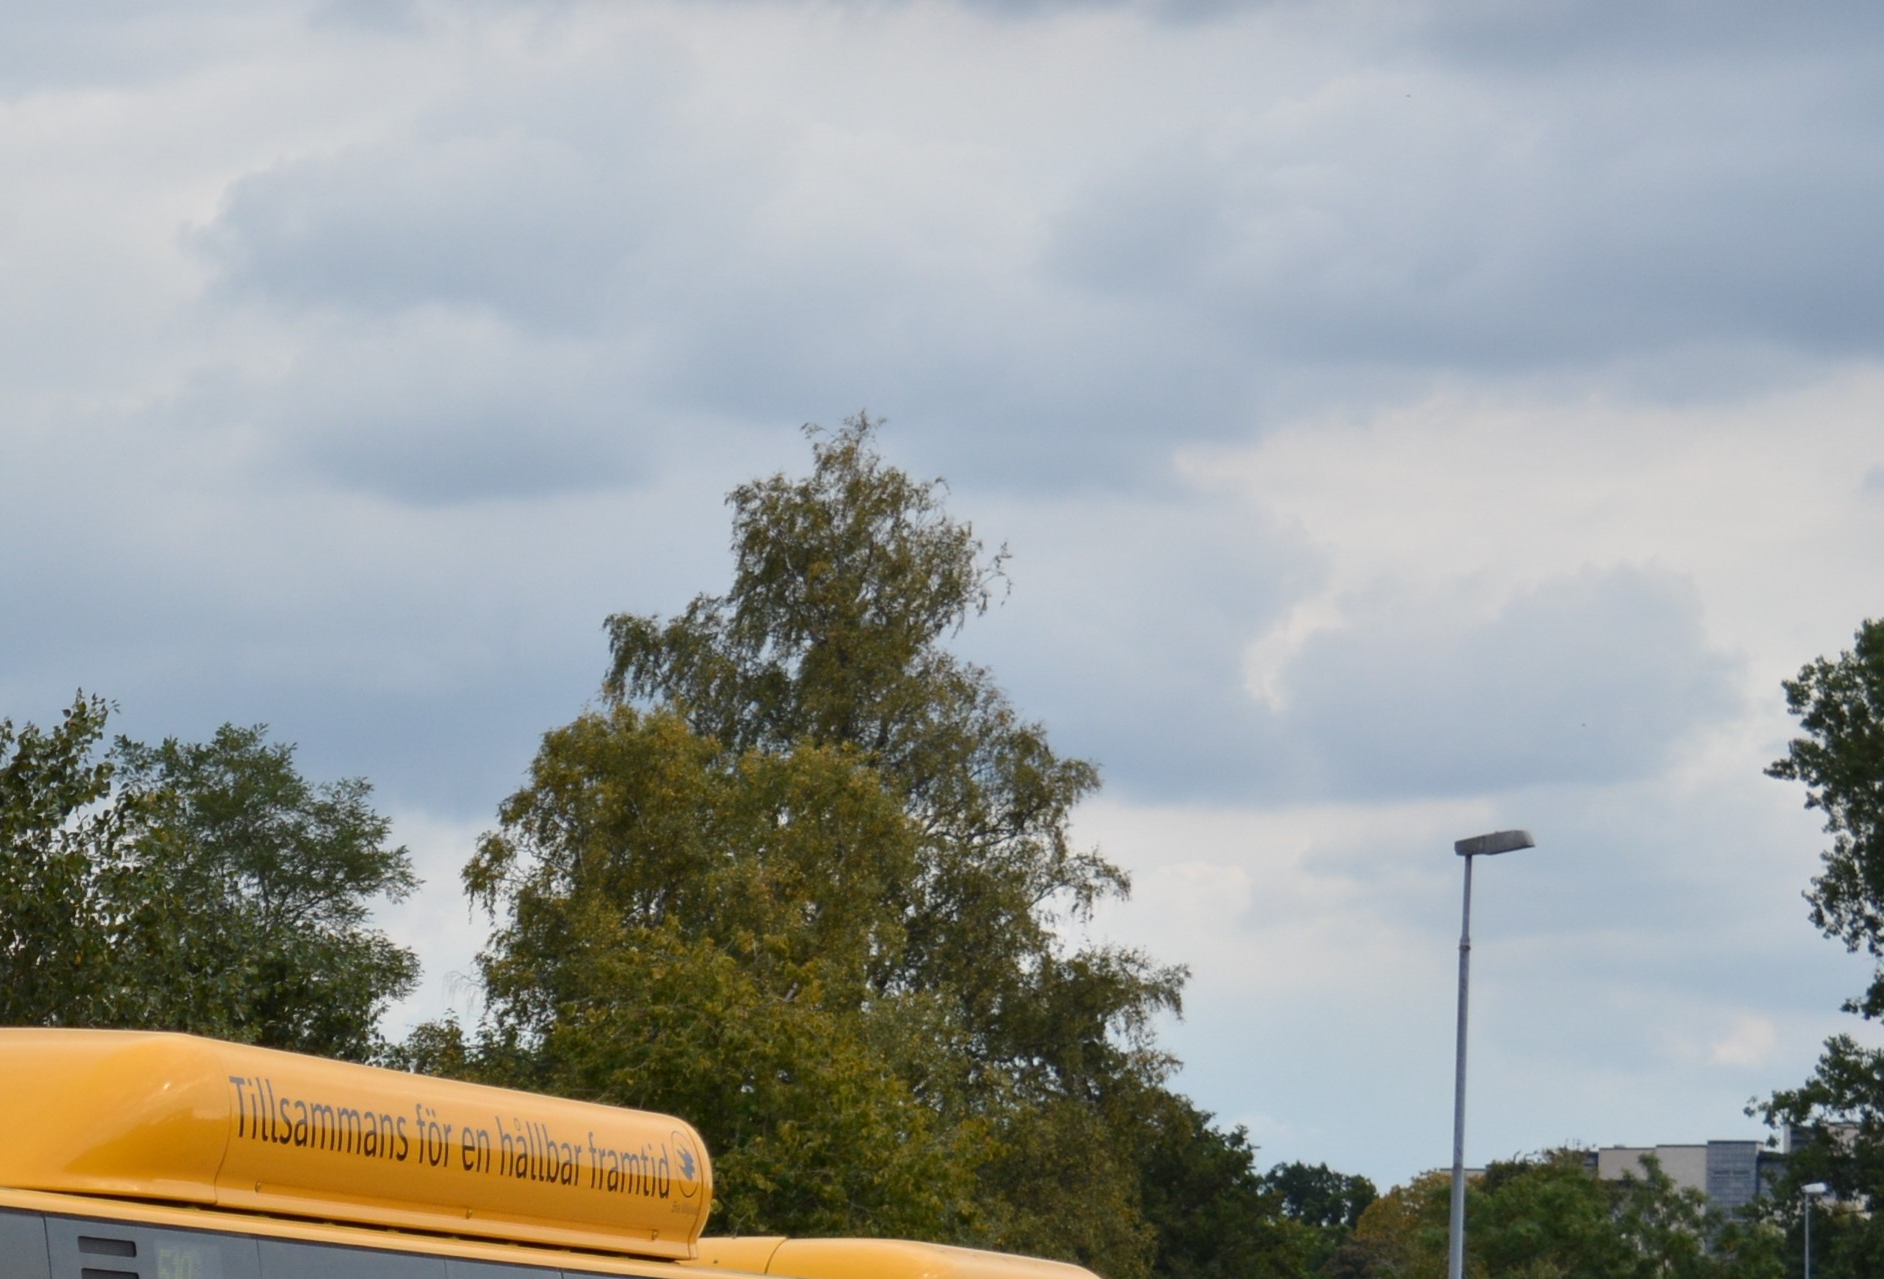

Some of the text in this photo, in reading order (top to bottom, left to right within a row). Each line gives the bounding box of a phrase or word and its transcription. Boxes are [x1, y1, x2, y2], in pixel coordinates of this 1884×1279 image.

[229, 1076, 671, 1199] Tillsammans för en hållbar framtid
